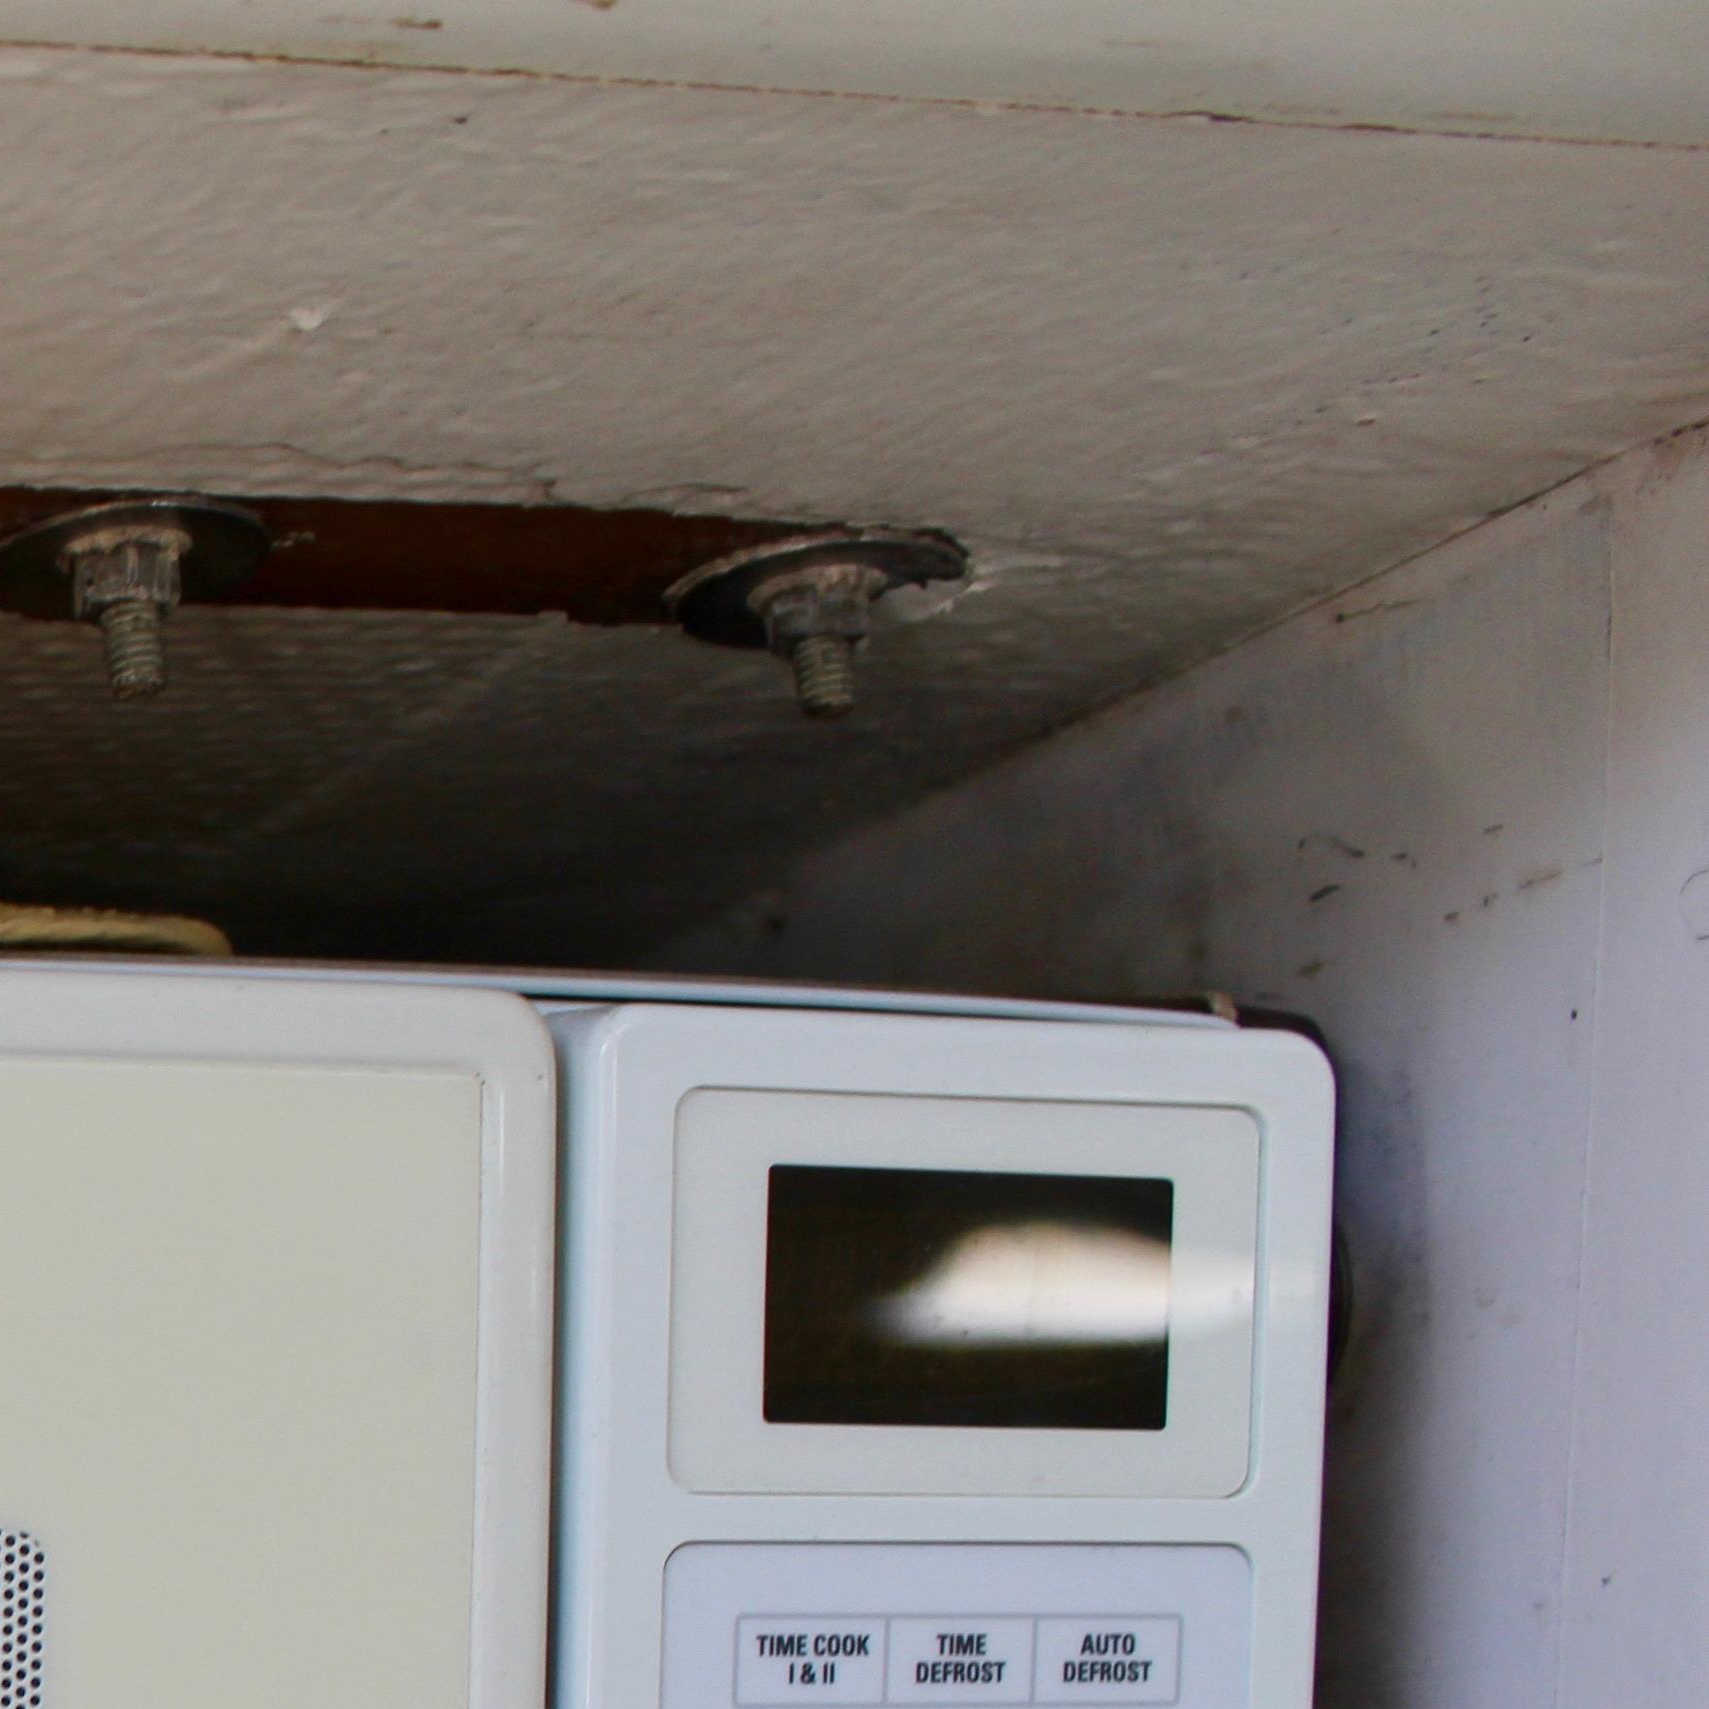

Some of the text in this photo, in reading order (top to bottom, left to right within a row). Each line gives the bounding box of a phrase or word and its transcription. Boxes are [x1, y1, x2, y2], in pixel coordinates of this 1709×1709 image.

[756, 1634, 870, 1657] TIME COOK
[937, 1633, 986, 1655] TIME
[1080, 1633, 1135, 1655] AUTO
[789, 1662, 835, 1684] I & II
[916, 1662, 1006, 1683] DEFROST
[1063, 1661, 1152, 1683] DEFROST
